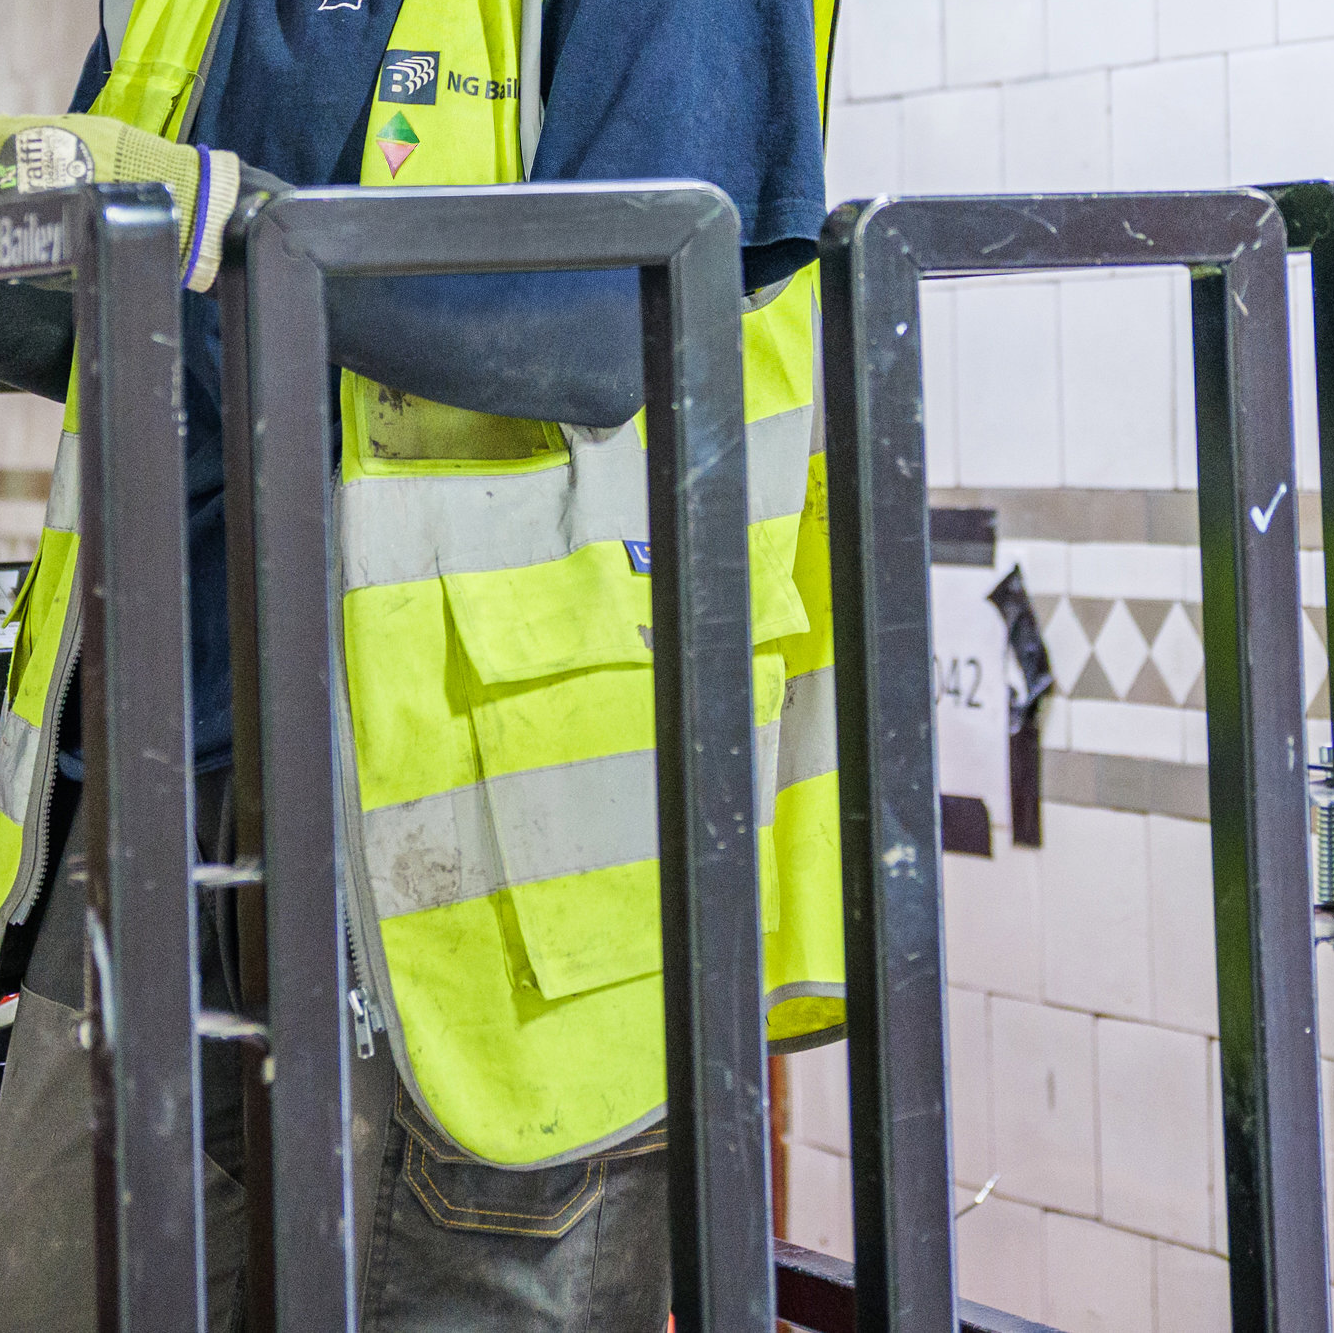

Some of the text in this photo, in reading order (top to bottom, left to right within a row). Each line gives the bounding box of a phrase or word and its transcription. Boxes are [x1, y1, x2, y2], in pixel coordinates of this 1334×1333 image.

[447, 70, 519, 100] NG Bail
[20, 138, 42, 188] raffi
